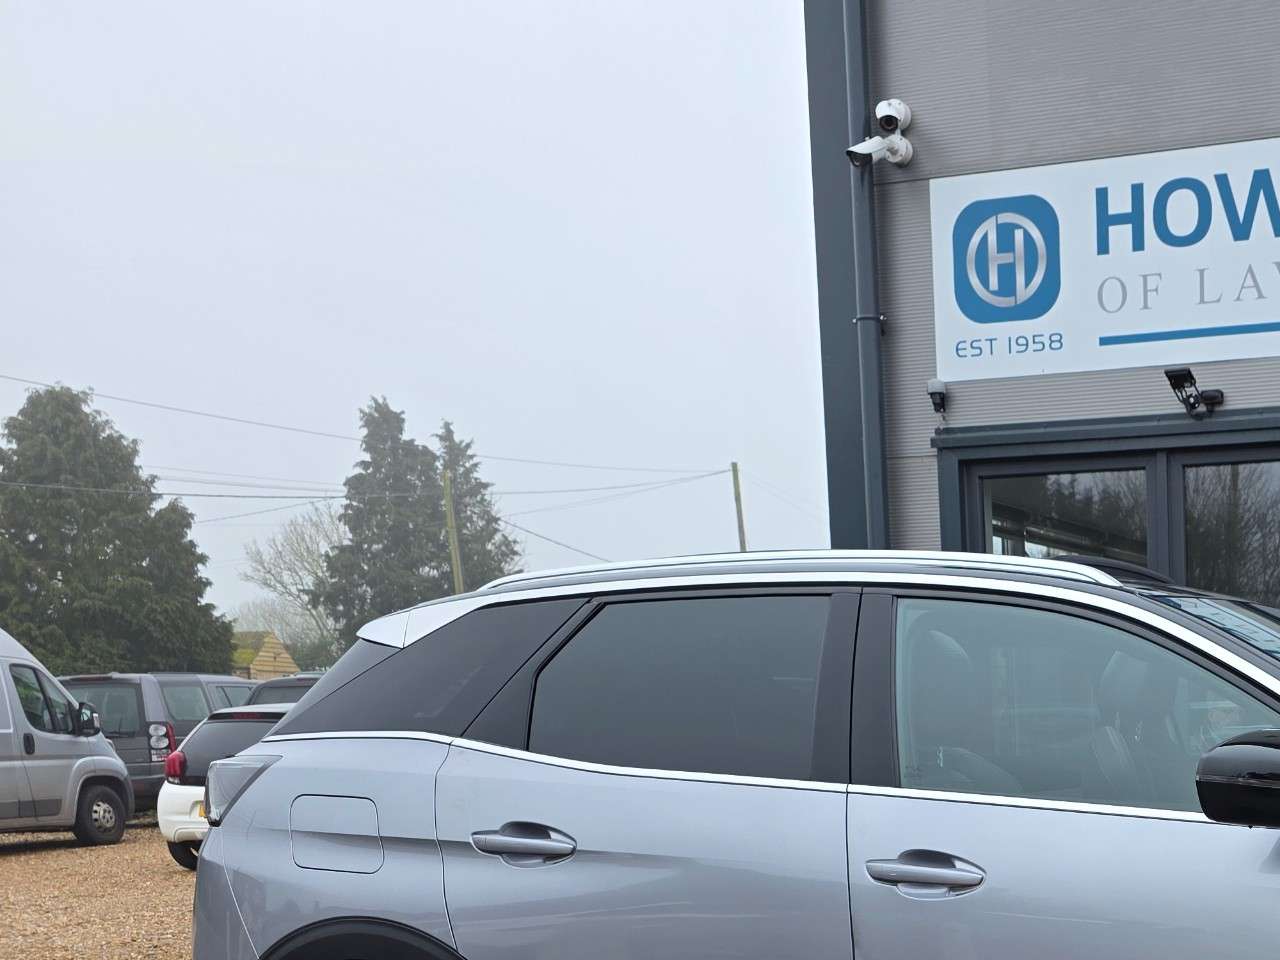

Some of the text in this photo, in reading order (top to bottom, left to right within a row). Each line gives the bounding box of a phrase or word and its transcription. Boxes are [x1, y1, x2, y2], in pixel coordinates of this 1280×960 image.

[1097, 273, 1163, 314] OF
[955, 332, 1064, 359] EST 1958
